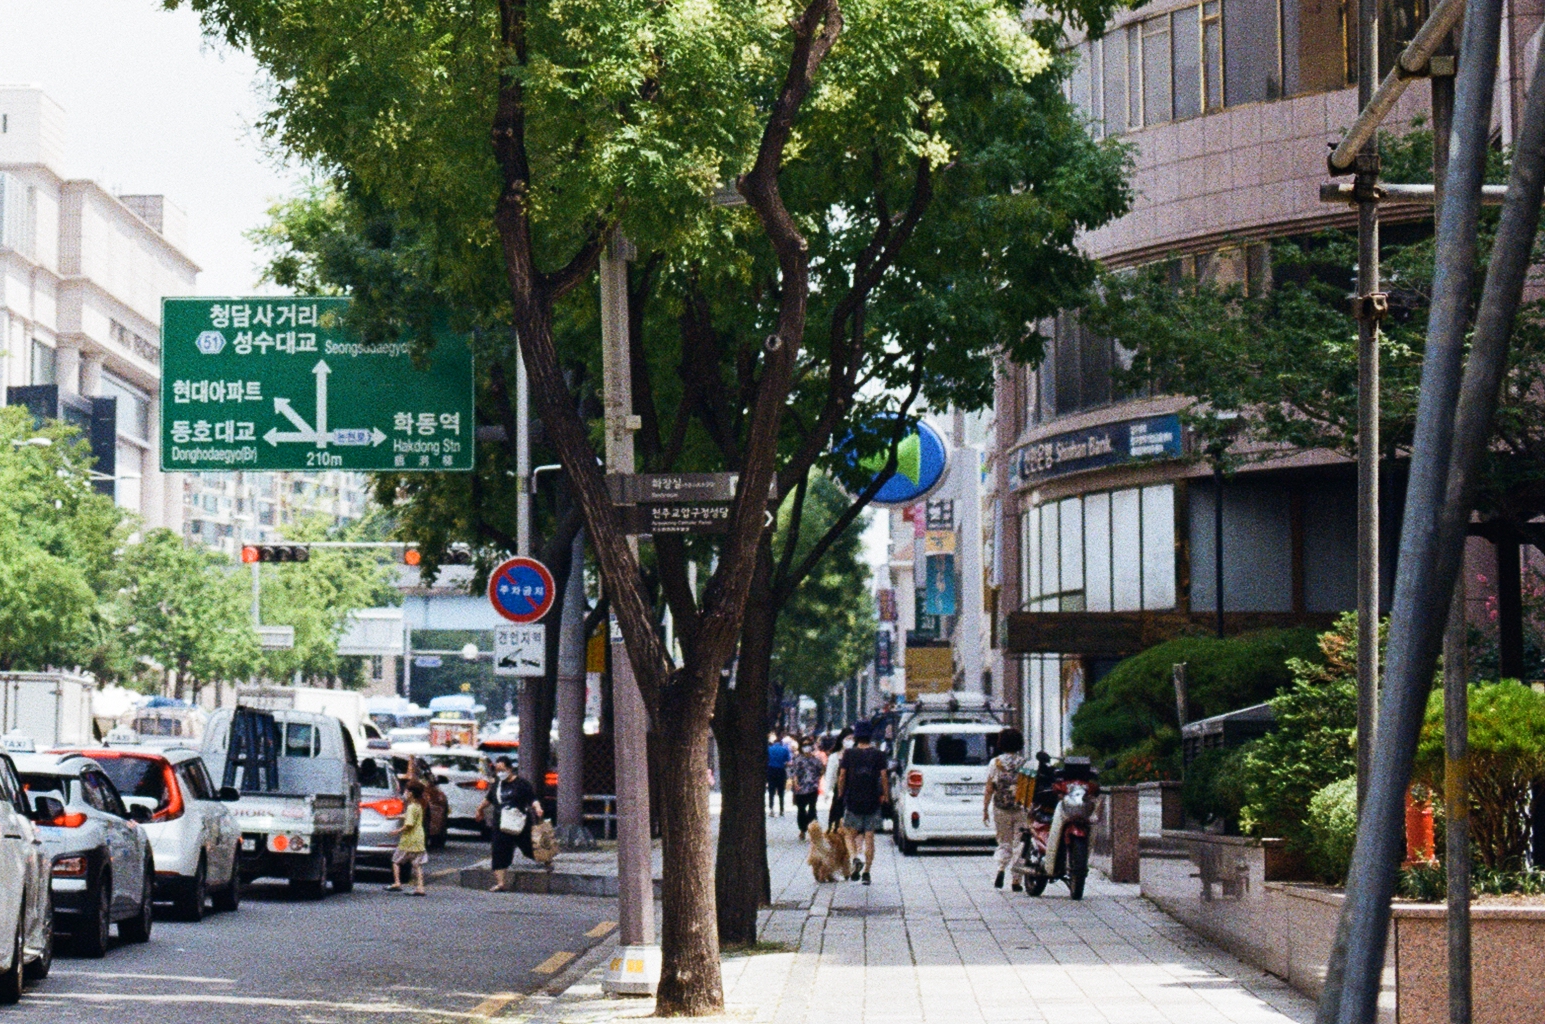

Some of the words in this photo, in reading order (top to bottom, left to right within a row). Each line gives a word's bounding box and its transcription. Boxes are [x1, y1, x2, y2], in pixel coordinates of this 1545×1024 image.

[210, 303, 318, 328] 청담사거리
[232, 331, 318, 355] 성수대교
[172, 380, 263, 403] 현대아파트
[170, 420, 257, 443] 동호대교
[393, 411, 460, 436] 학동역
[393, 439, 440, 456] Hakdong
[306, 452, 342, 467] 210m
[499, 585, 544, 596] 주차금지
[499, 631, 541, 645] 견인지역
